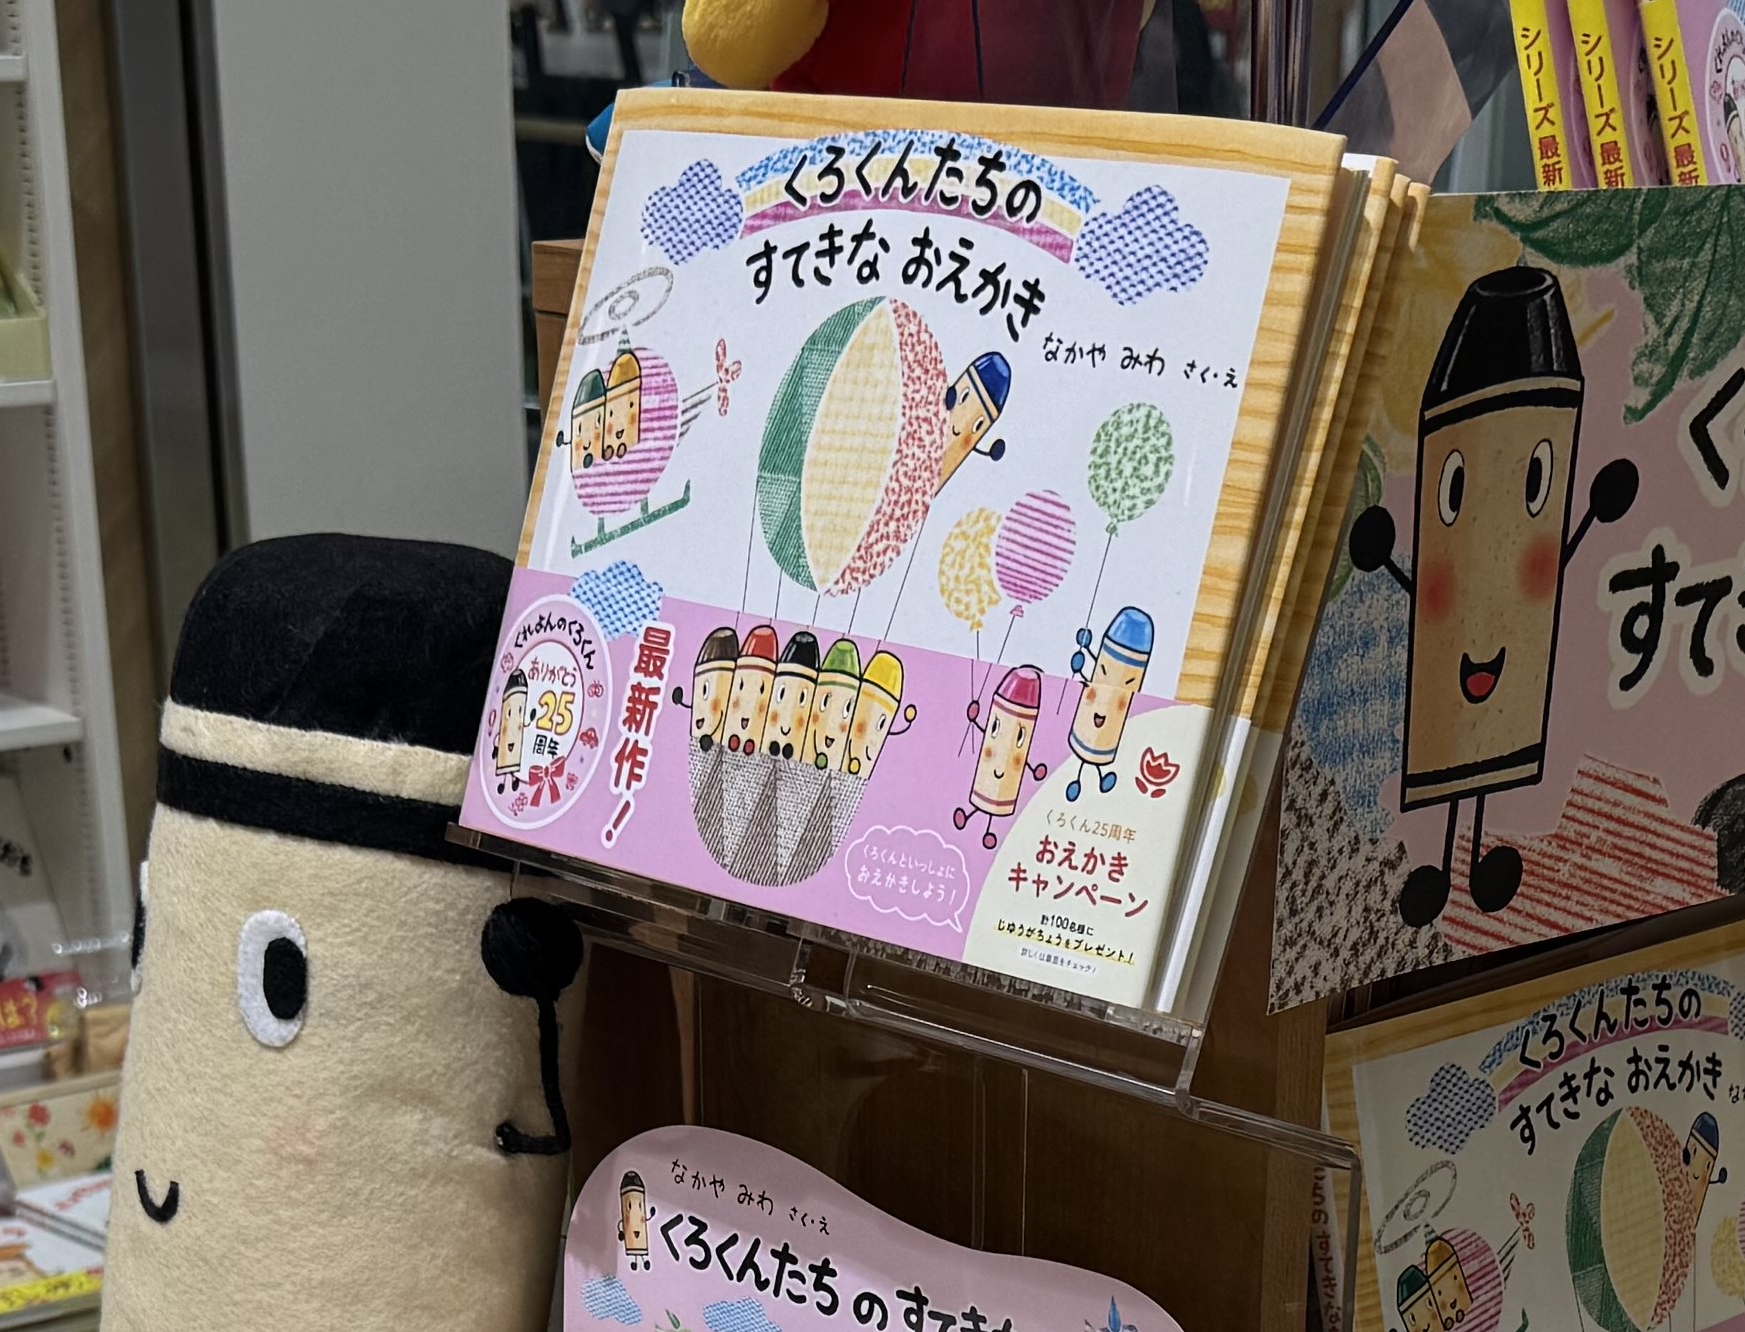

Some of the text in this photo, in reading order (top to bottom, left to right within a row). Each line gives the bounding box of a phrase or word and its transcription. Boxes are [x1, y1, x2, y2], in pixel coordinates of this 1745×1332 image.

[784, 141, 1042, 222] くろくんたちの
[745, 228, 1048, 340] すてきな おえかき
[1044, 336, 1107, 366] なかや
[1120, 345, 1165, 377] みわ
[515, 612, 596, 669] くれよんのくろくん
[527, 656, 577, 688] ありがとう
[535, 690, 576, 736] 25
[605, 626, 671, 842] 最新作!
[533, 734, 561, 759] 周年
[1045, 809, 1137, 842] くろくん25周年
[863, 844, 956, 879] くろくんといっしょに
[1036, 835, 1129, 883] おえかき
[857, 865, 957, 906] おえかきしよう!
[1008, 863, 1149, 918] キャンペーン
[1518, 976, 1704, 1071] くろくんたちの
[1510, 1045, 1724, 1154] すてきな おえかき
